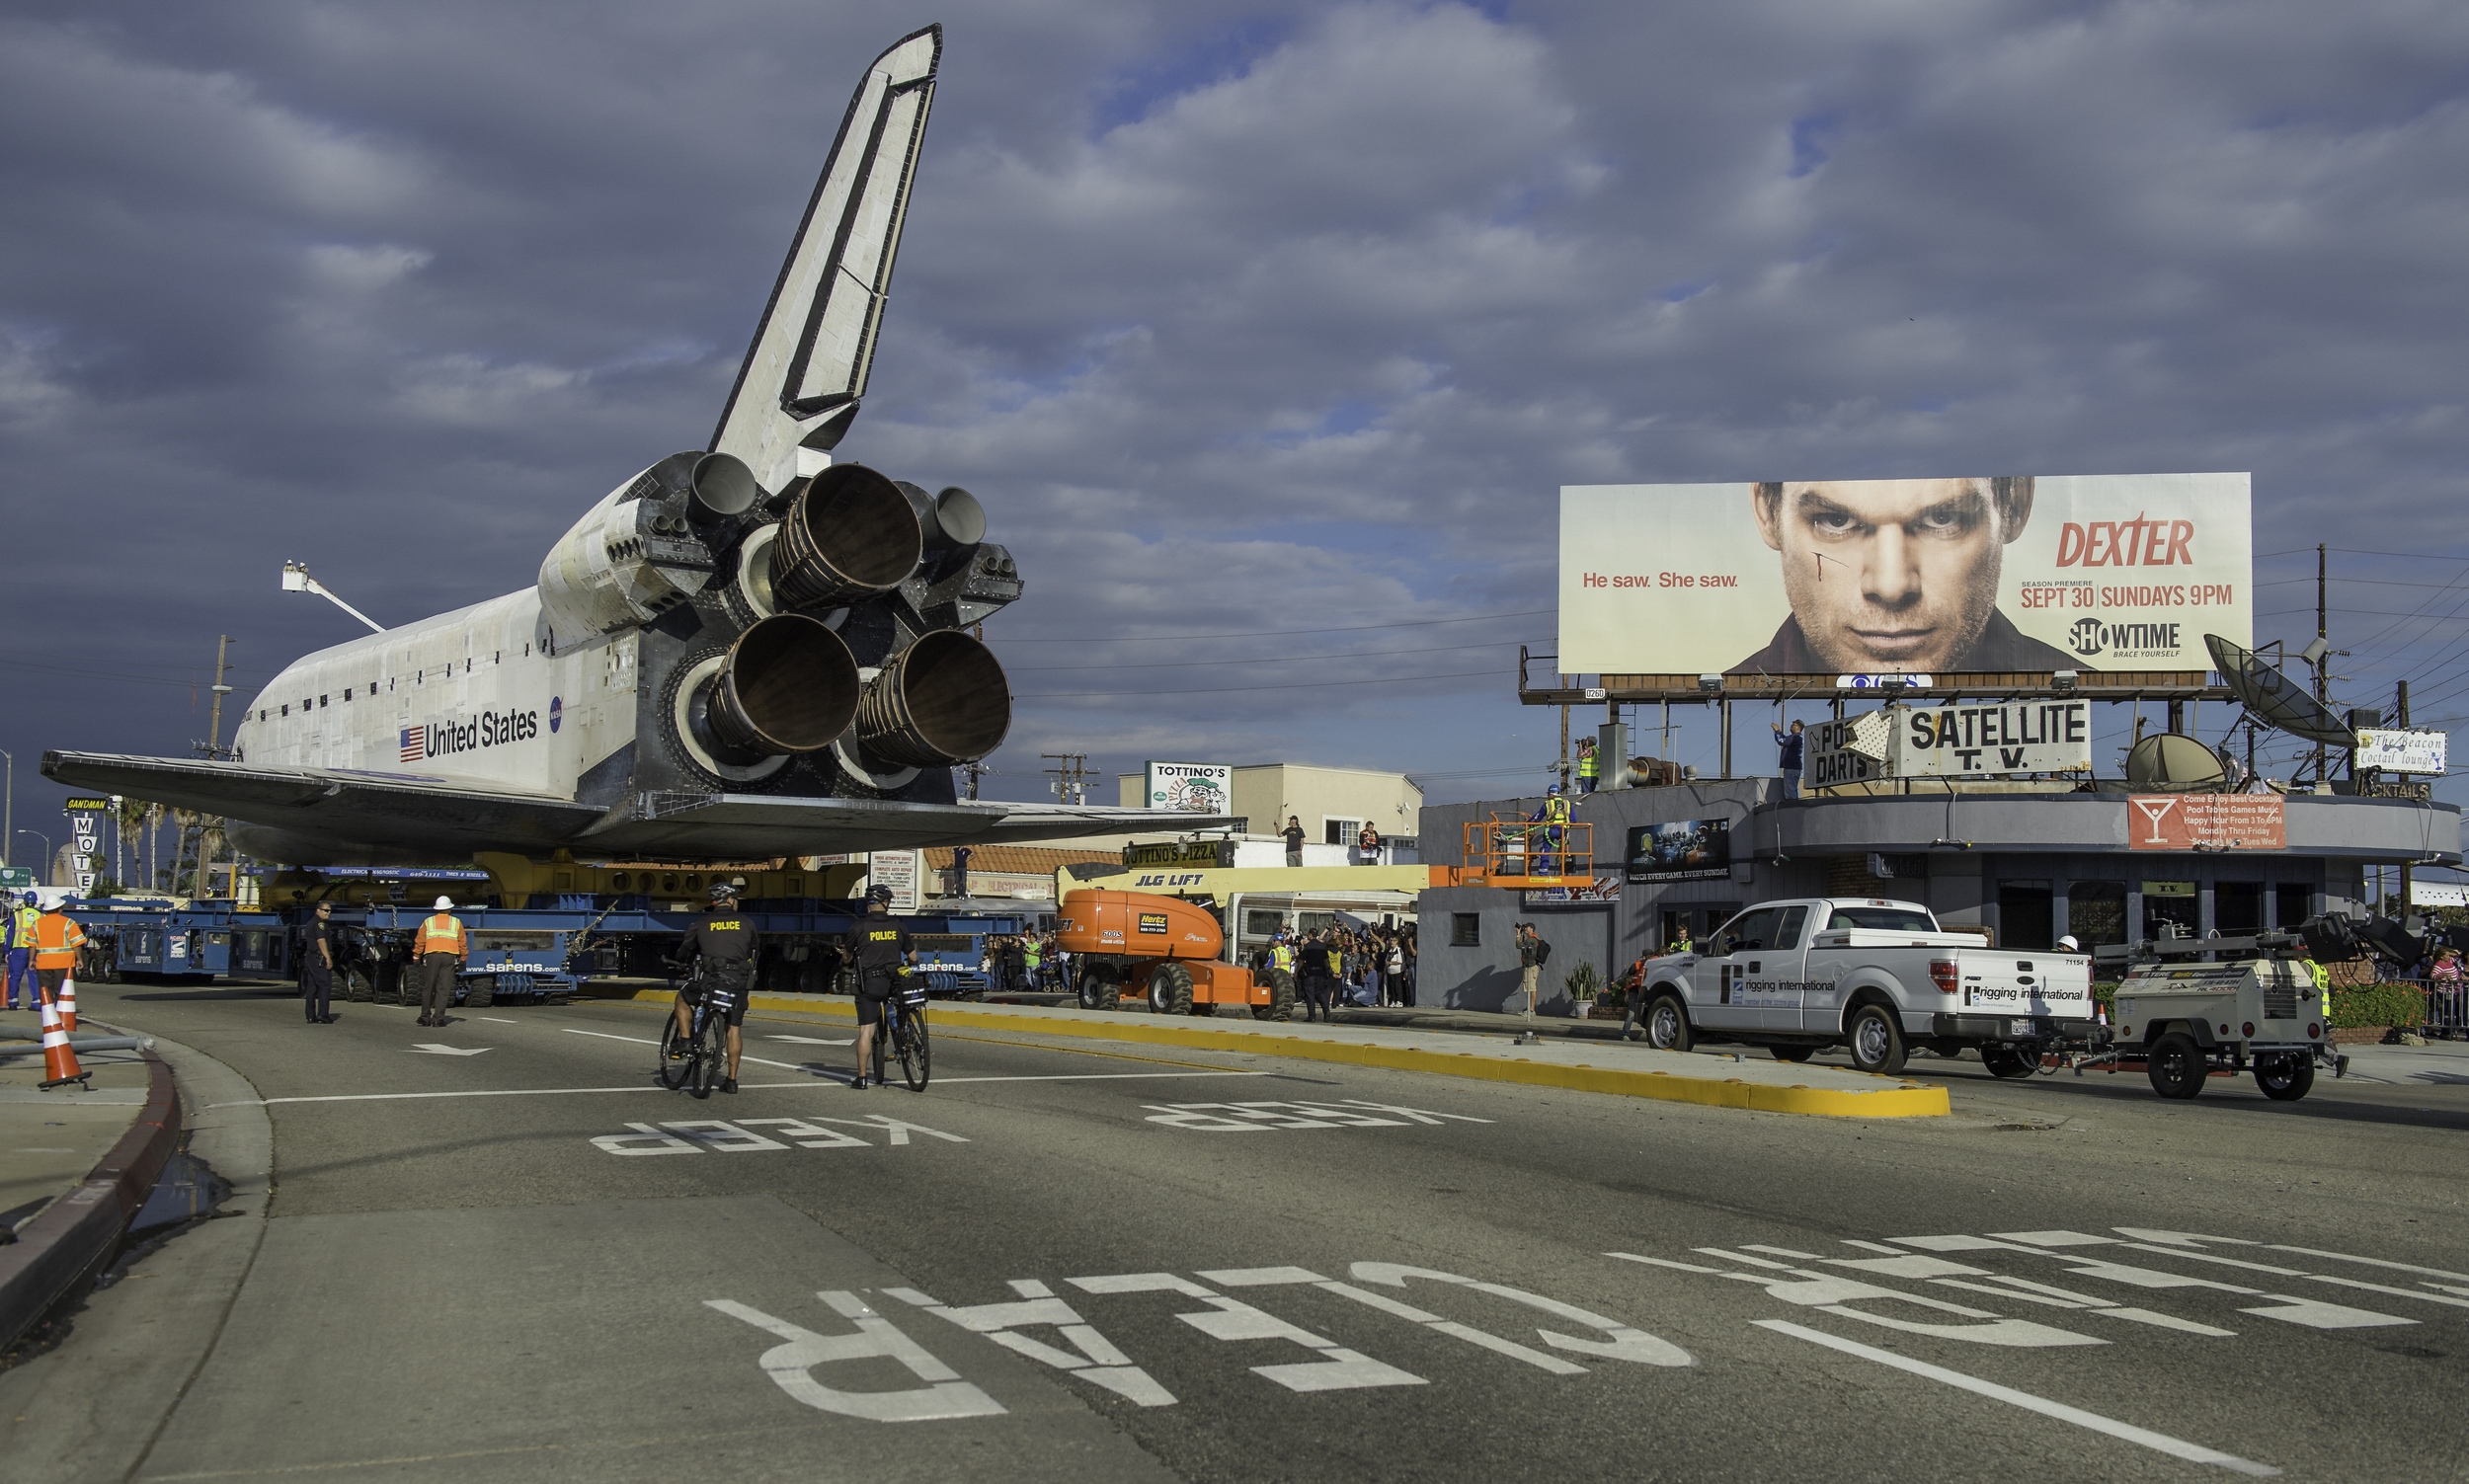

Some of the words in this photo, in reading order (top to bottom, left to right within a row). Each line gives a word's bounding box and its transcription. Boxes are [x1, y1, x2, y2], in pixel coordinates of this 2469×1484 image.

[2055, 510, 2194, 568] DEXTER
[1583, 572, 1608, 588] He
[1612, 575, 1651, 588] saw.
[1658, 571, 1695, 588] She
[1700, 575, 1738, 587] saw.
[2021, 587, 2067, 608] SEPT
[2071, 587, 2094, 608] 30
[2101, 585, 2186, 607] SUNDAYS
[2190, 584, 2233, 605] 9PM
[2068, 617, 2181, 656] SHOWTIME
[2140, 650, 2181, 659] YOURSELF
[549, 709, 562, 720] NASA
[426, 715, 477, 758] United
[481, 708, 537, 747] States
[1911, 703, 2086, 750] SATELLITE
[2373, 734, 2395, 746] The
[2400, 736, 2441, 749] Beacon
[1954, 748, 1982, 770] T.
[1999, 747, 2029, 769] V.
[2360, 750, 2397, 764] Coctail
[2401, 751, 2433, 769] lounge
[1157, 765, 1227, 778] TOTTINO'S
[1816, 752, 1868, 784] DARTS
[1168, 777, 1188, 802] PIZZA
[67, 799, 107, 810] SANDMAN
[2183, 795, 2206, 804] Come
[2207, 795, 2229, 806] Enoy
[2184, 817, 2208, 826] Happy
[2210, 817, 2229, 825] Hour
[2197, 827, 2227, 837] Mondy
[2247, 827, 2270, 837] Friday
[1135, 875, 1165, 887] JLG
[1167, 874, 1204, 887] LIFT
[1666, 871, 1684, 880] GAME.
[1704, 868, 1728, 877] SUNDAY.
[710, 920, 741, 931] POLICE
[1141, 914, 1166, 925] Hertz
[870, 930, 897, 941] POLICE
[134, 955, 152, 964] sarens
[243, 959, 264, 970] sarens
[465, 963, 561, 973] www.sarens.com
[1745, 980, 1776, 993] rigging
[1779, 979, 1836, 991] international
[1979, 986, 2017, 1000] rigging
[2020, 987, 2083, 1000] international
[589, 1115, 971, 1157] KEEP
[701, 1260, 1695, 1425] CLEAR
